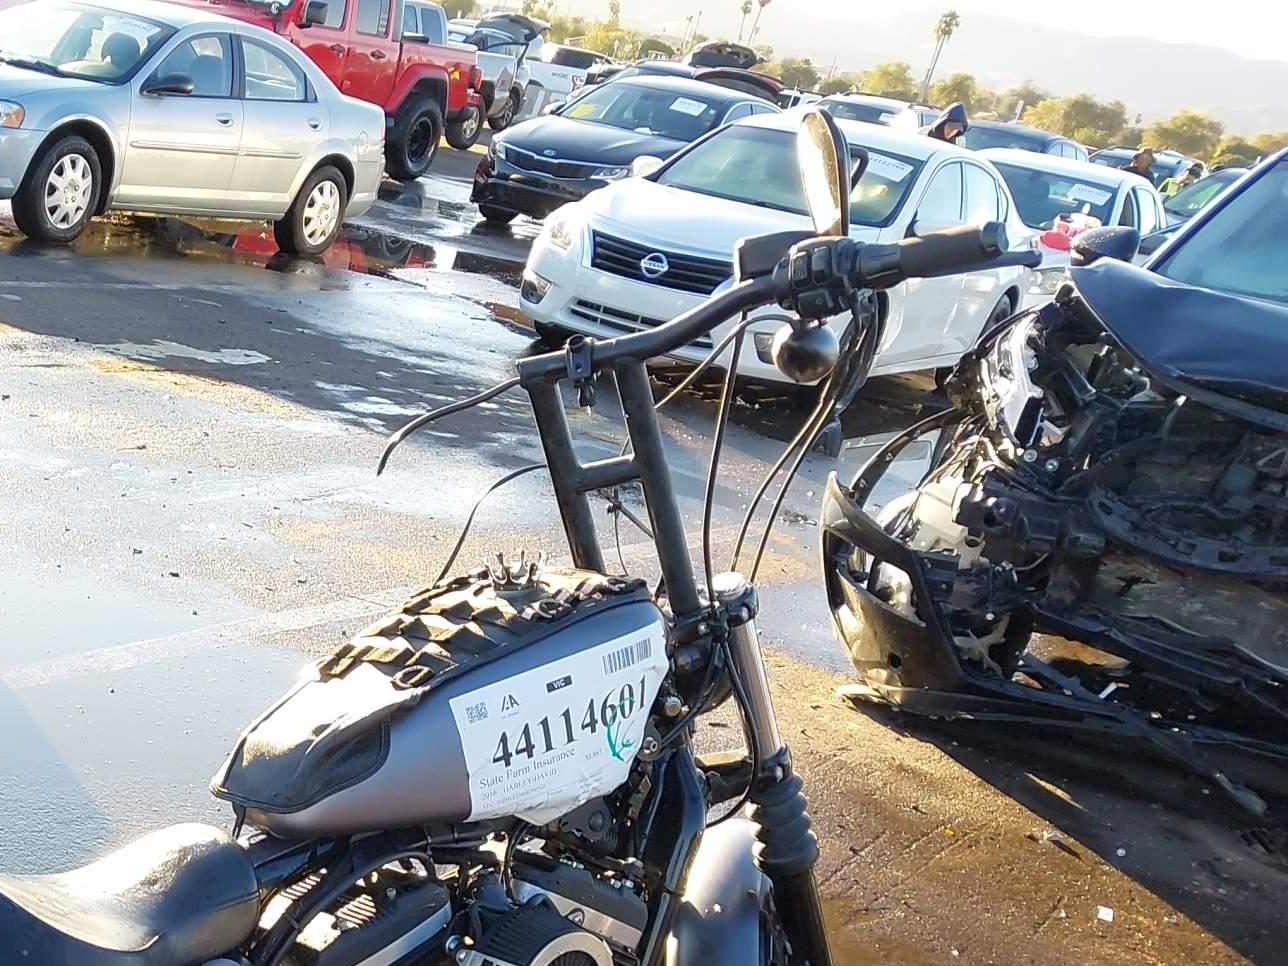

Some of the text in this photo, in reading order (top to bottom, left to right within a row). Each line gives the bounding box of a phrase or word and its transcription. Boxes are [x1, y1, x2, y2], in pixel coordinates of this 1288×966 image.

[553, 679, 566, 689] VIC
[492, 674, 646, 768] 44114601
[479, 747, 576, 790] State Farm Insurance
